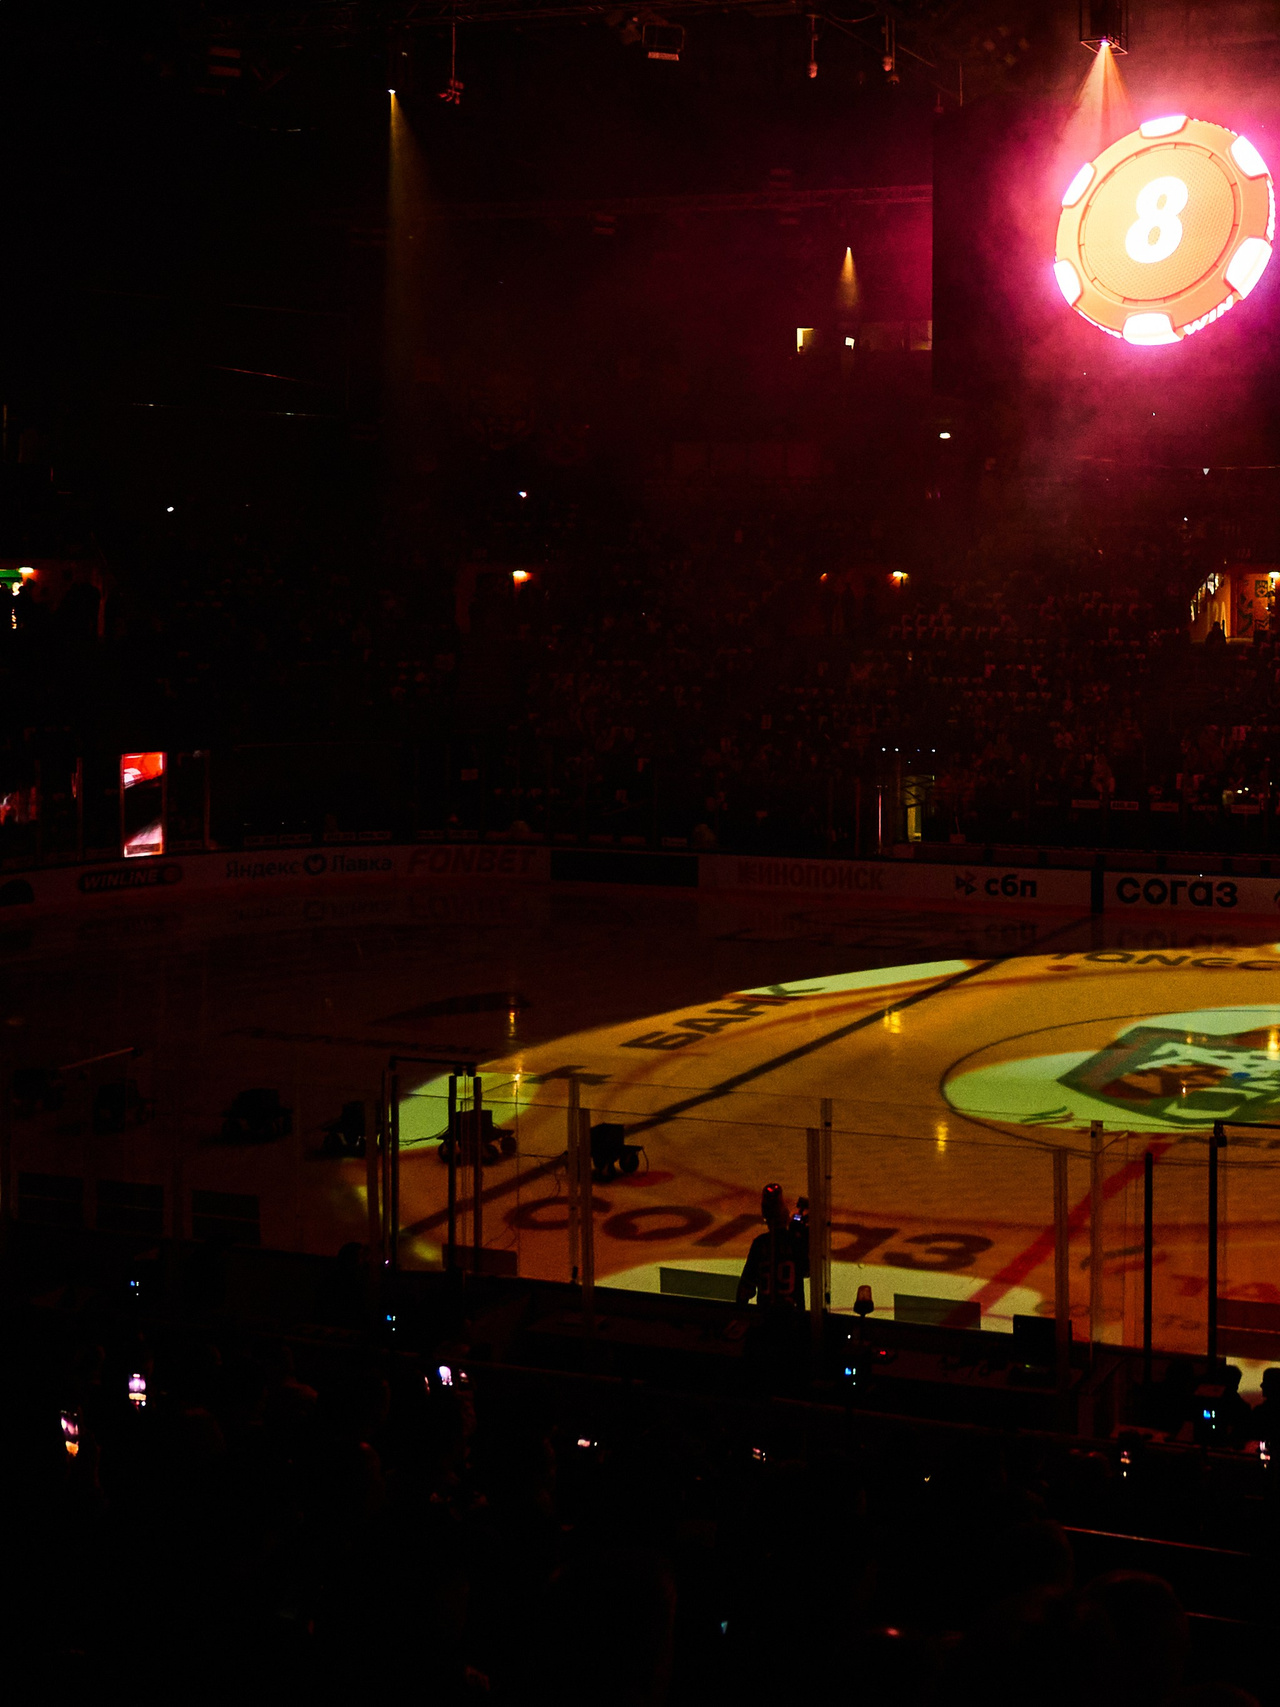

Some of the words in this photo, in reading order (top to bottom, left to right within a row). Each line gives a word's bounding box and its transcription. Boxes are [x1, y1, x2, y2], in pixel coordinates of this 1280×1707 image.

[1125, 176, 1189, 264] 8
[226, 858, 300, 879] Яндекс
[332, 855, 392, 873] Лавка
[407, 845, 538, 876] FONBET
[985, 874, 1037, 897] сбп
[622, 980, 824, 1052] БАНК
